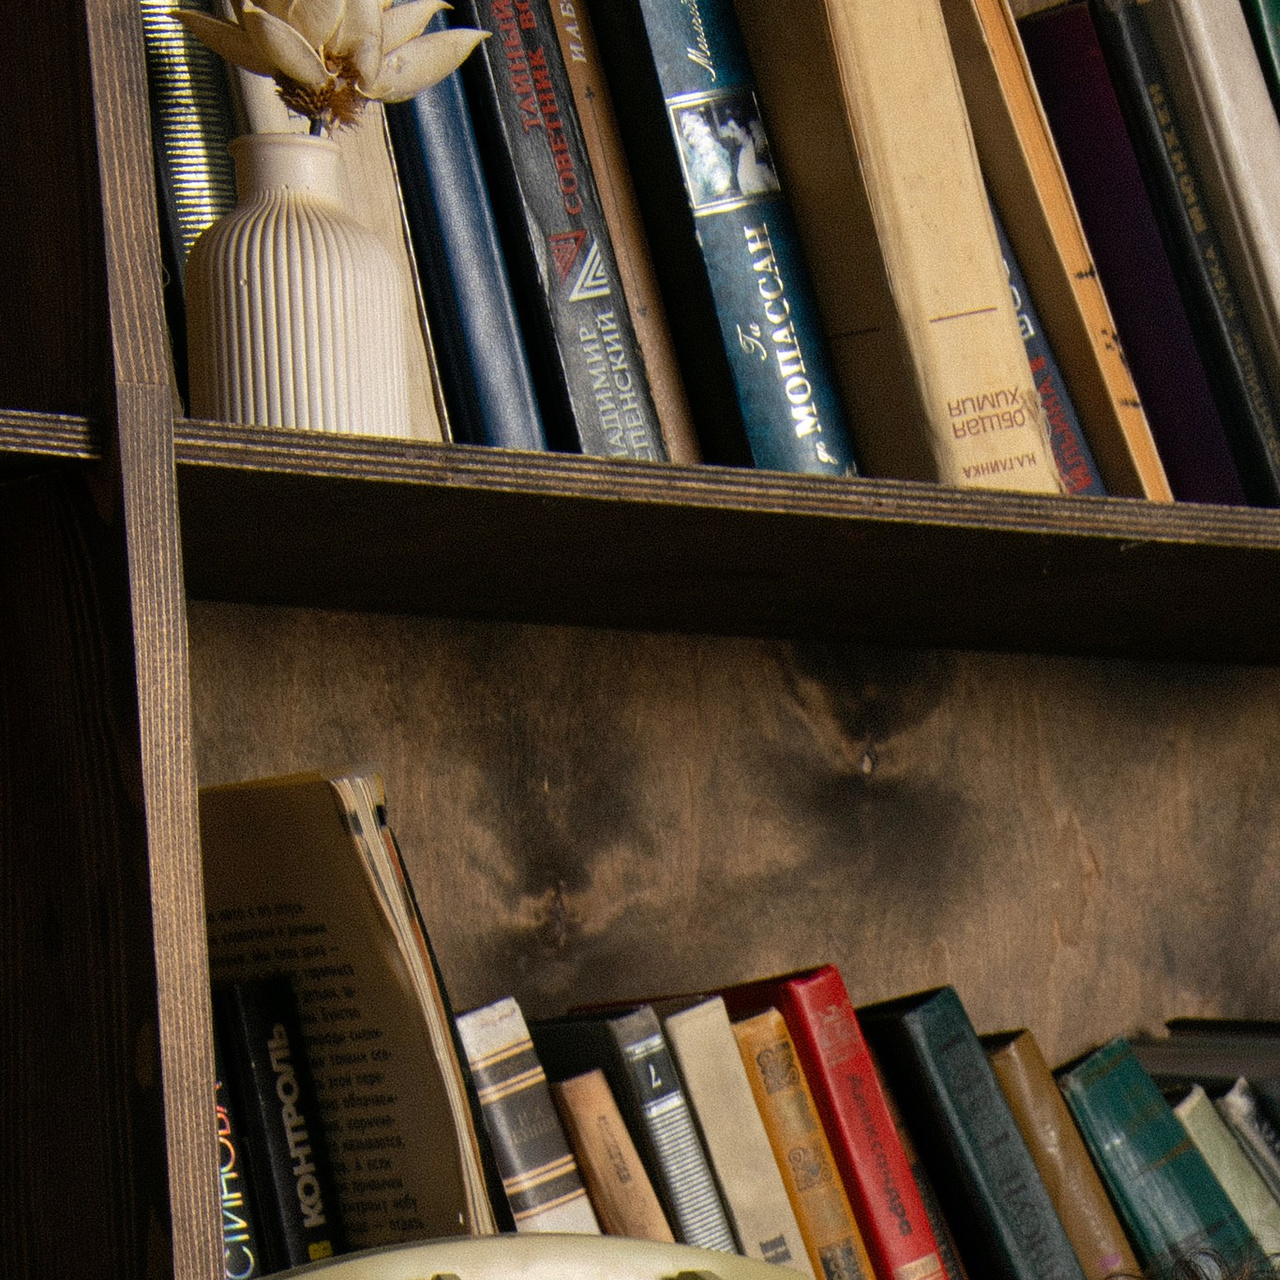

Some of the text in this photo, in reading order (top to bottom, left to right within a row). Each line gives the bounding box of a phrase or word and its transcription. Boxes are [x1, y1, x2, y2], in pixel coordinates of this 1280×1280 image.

[528, 47, 582, 215] СОВЕТНИК
[745, 224, 822, 438] МОПАССАН
[948, 388, 1019, 417] ХИМИЯ
[267, 1023, 326, 1228] КОНТРОЛЬ
